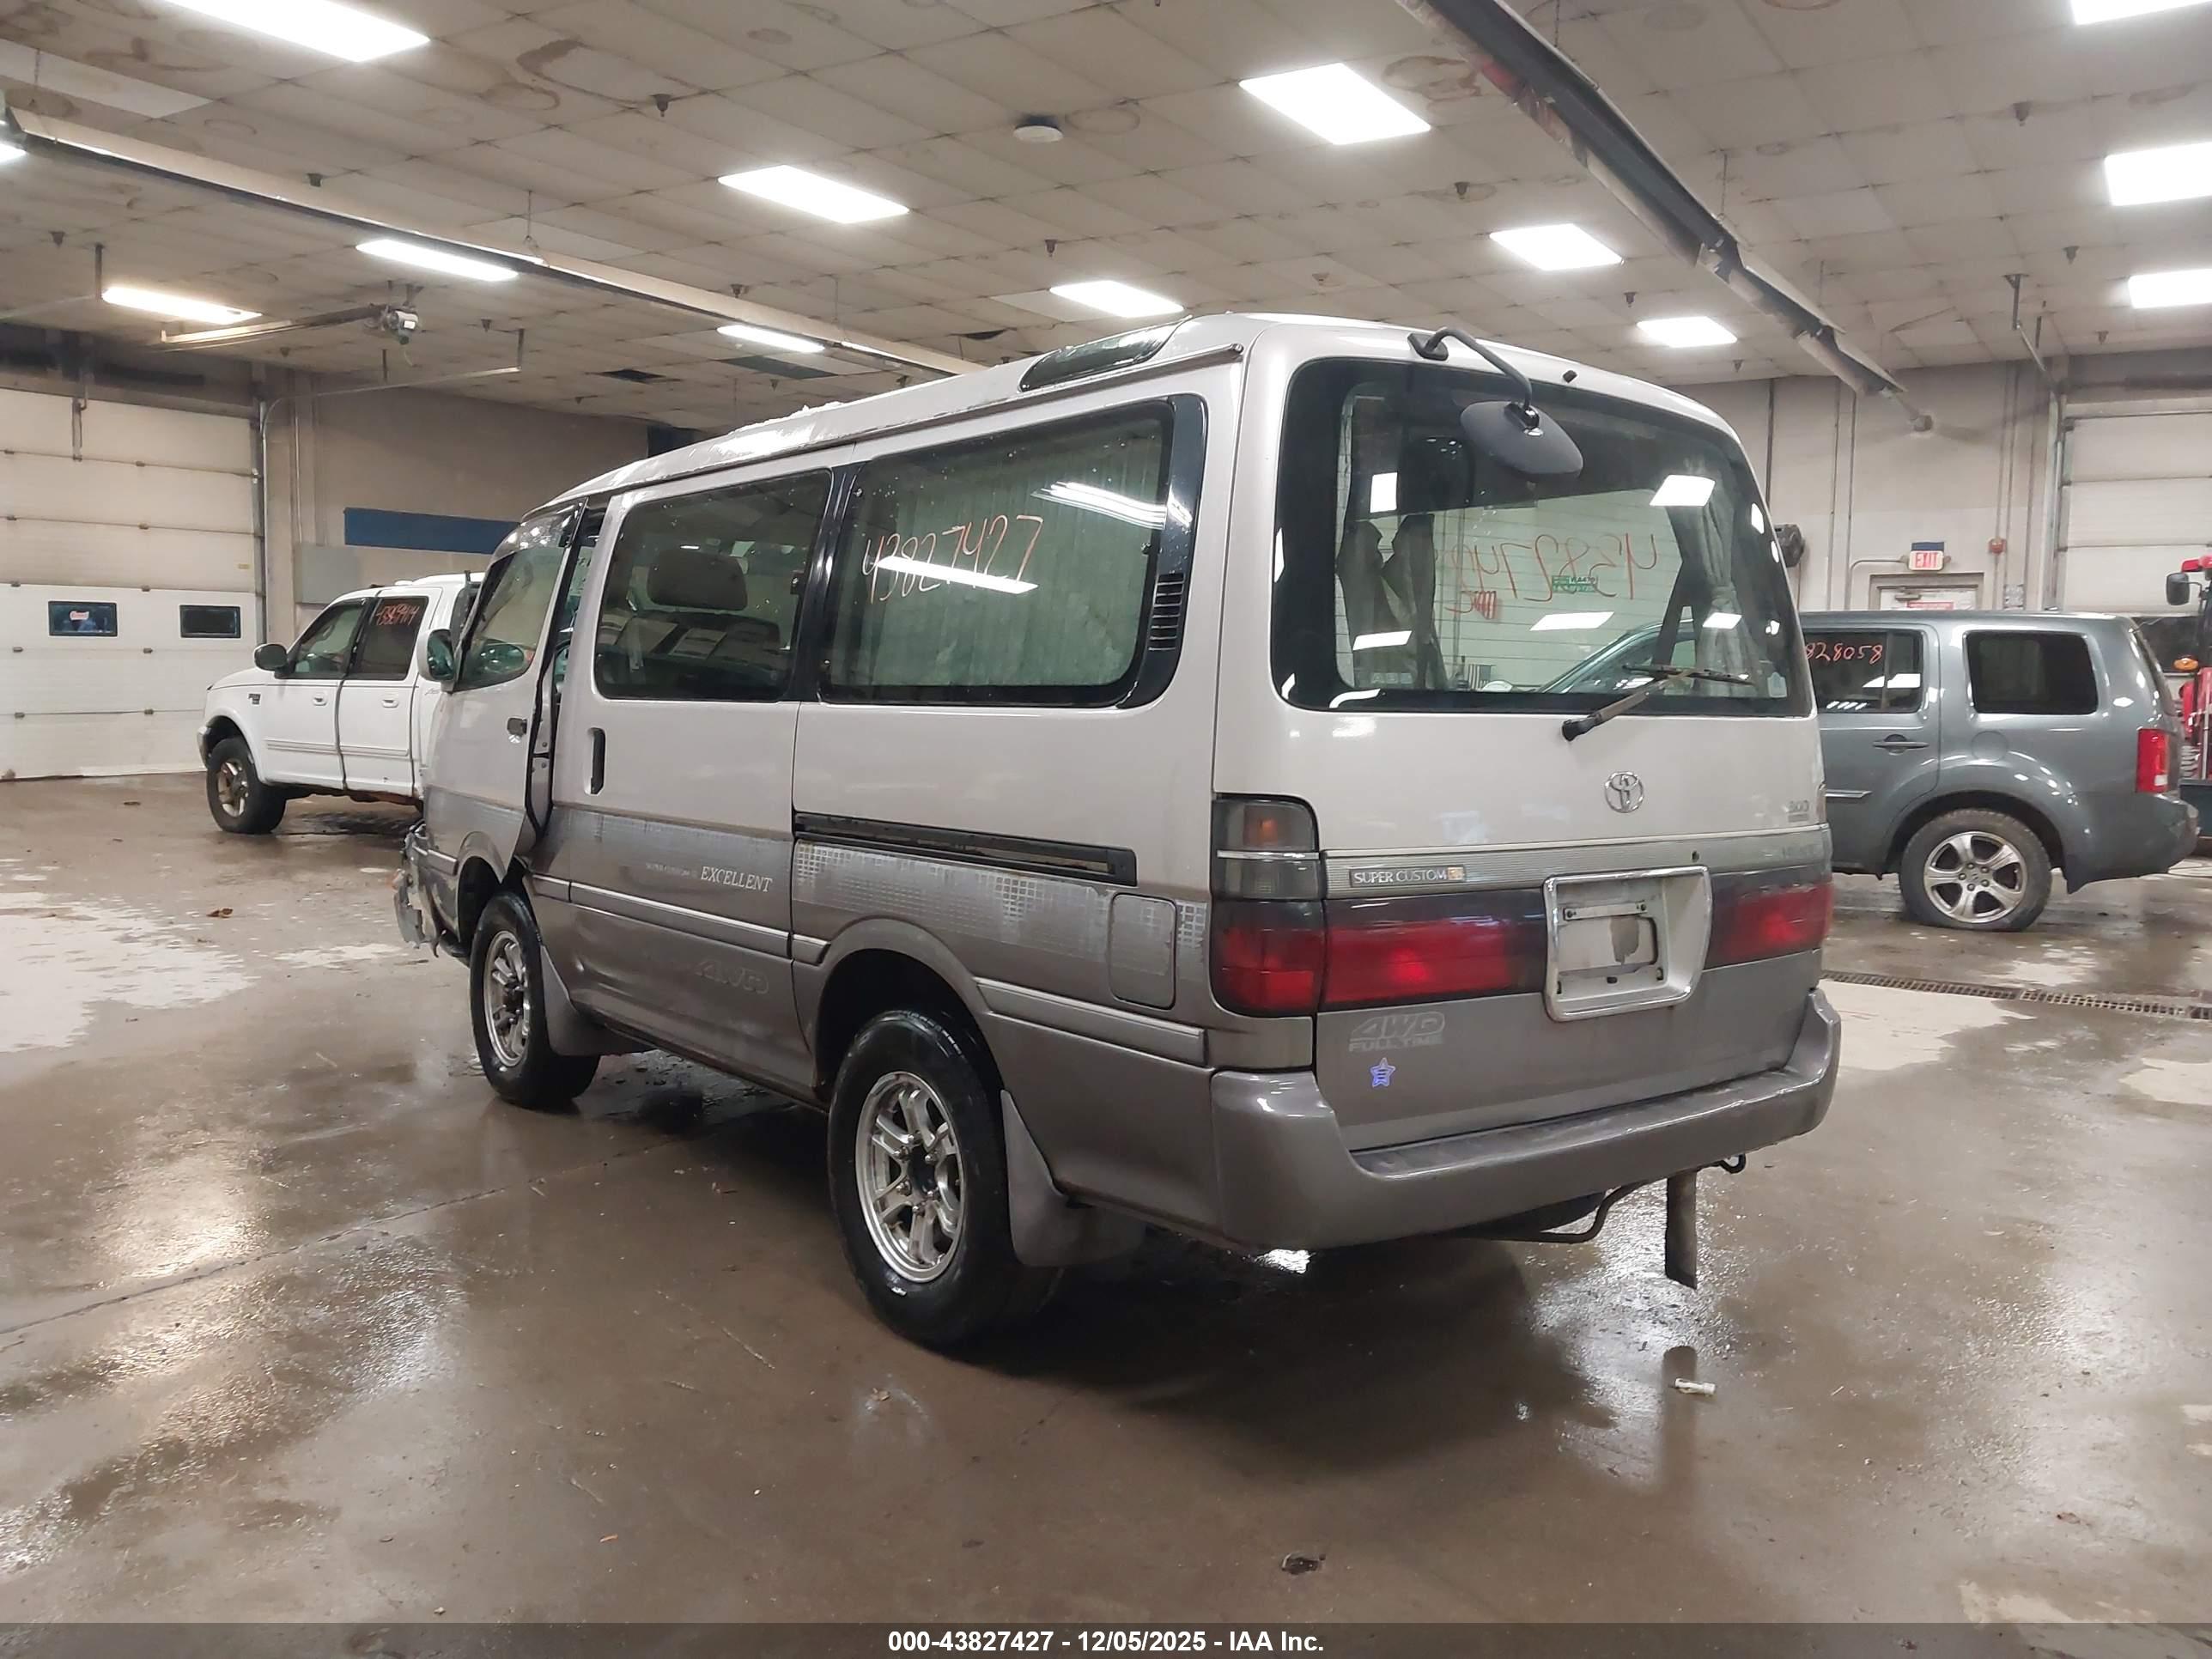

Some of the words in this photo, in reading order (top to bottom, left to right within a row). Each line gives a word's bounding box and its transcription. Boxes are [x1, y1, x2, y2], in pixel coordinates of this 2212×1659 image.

[862, 514, 1044, 604] 43827427
[1915, 552, 1938, 568] EXIT
[701, 866, 773, 892] EXCELLENT
[1353, 872, 1394, 884] SUPER
[1395, 869, 1447, 882] CUSTOM
[1350, 1012, 1445, 1042] 4WD
